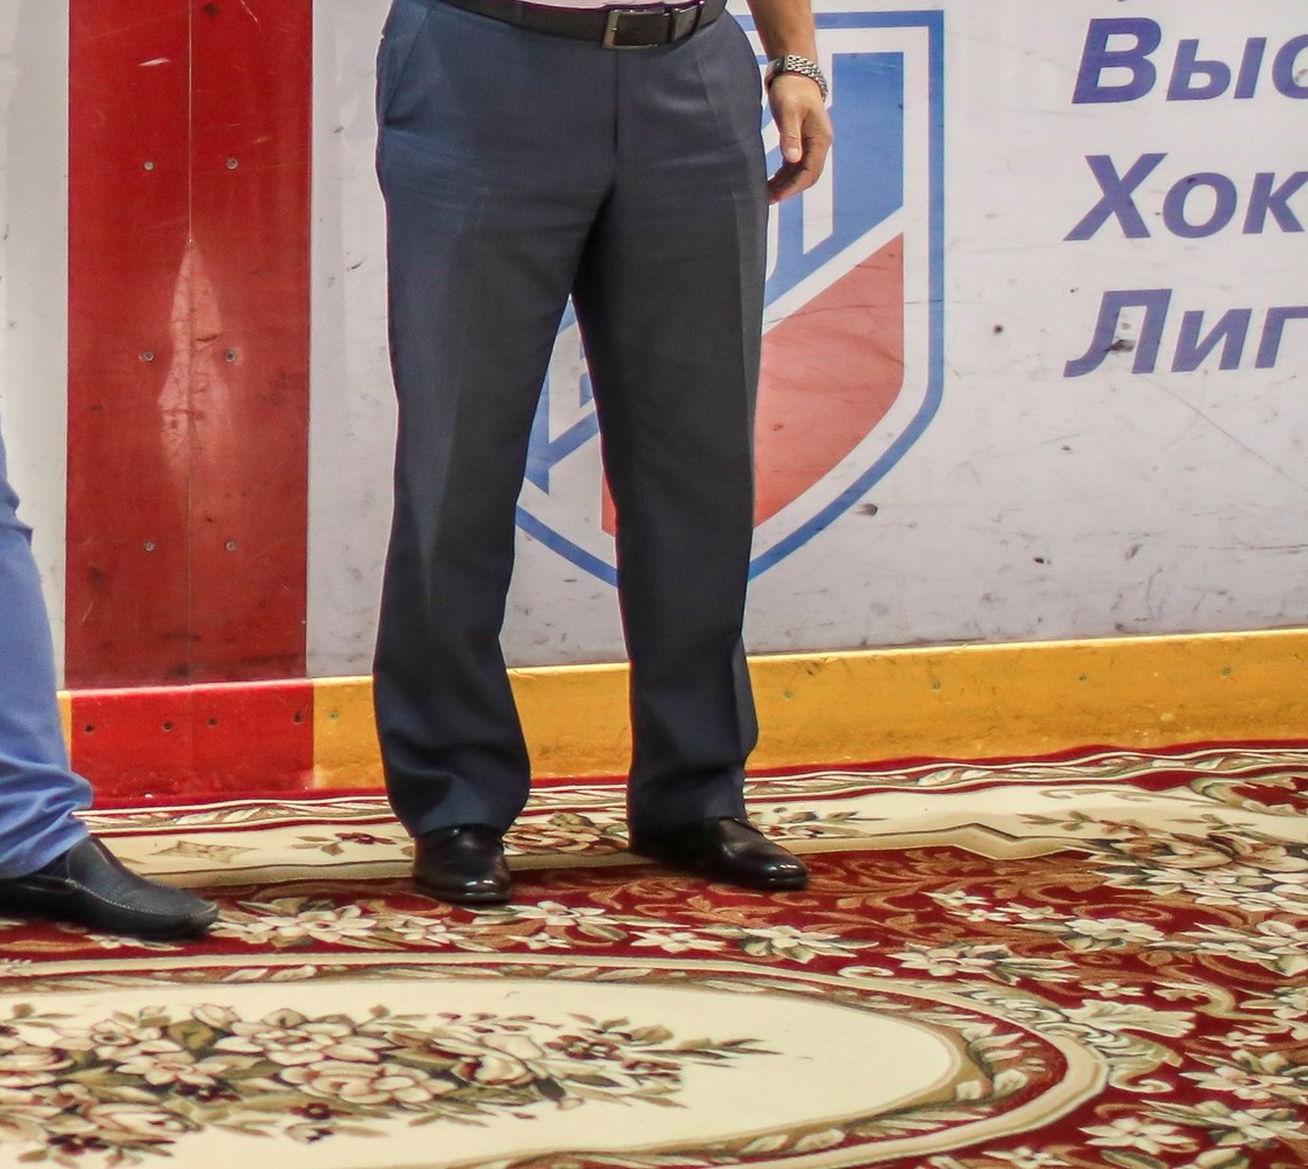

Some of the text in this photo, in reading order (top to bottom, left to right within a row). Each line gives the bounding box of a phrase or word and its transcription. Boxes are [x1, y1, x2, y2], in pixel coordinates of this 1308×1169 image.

[1070, 16, 1308, 104] Выс
[1062, 152, 1308, 242] Хок
[1062, 288, 1308, 378] Лиг
